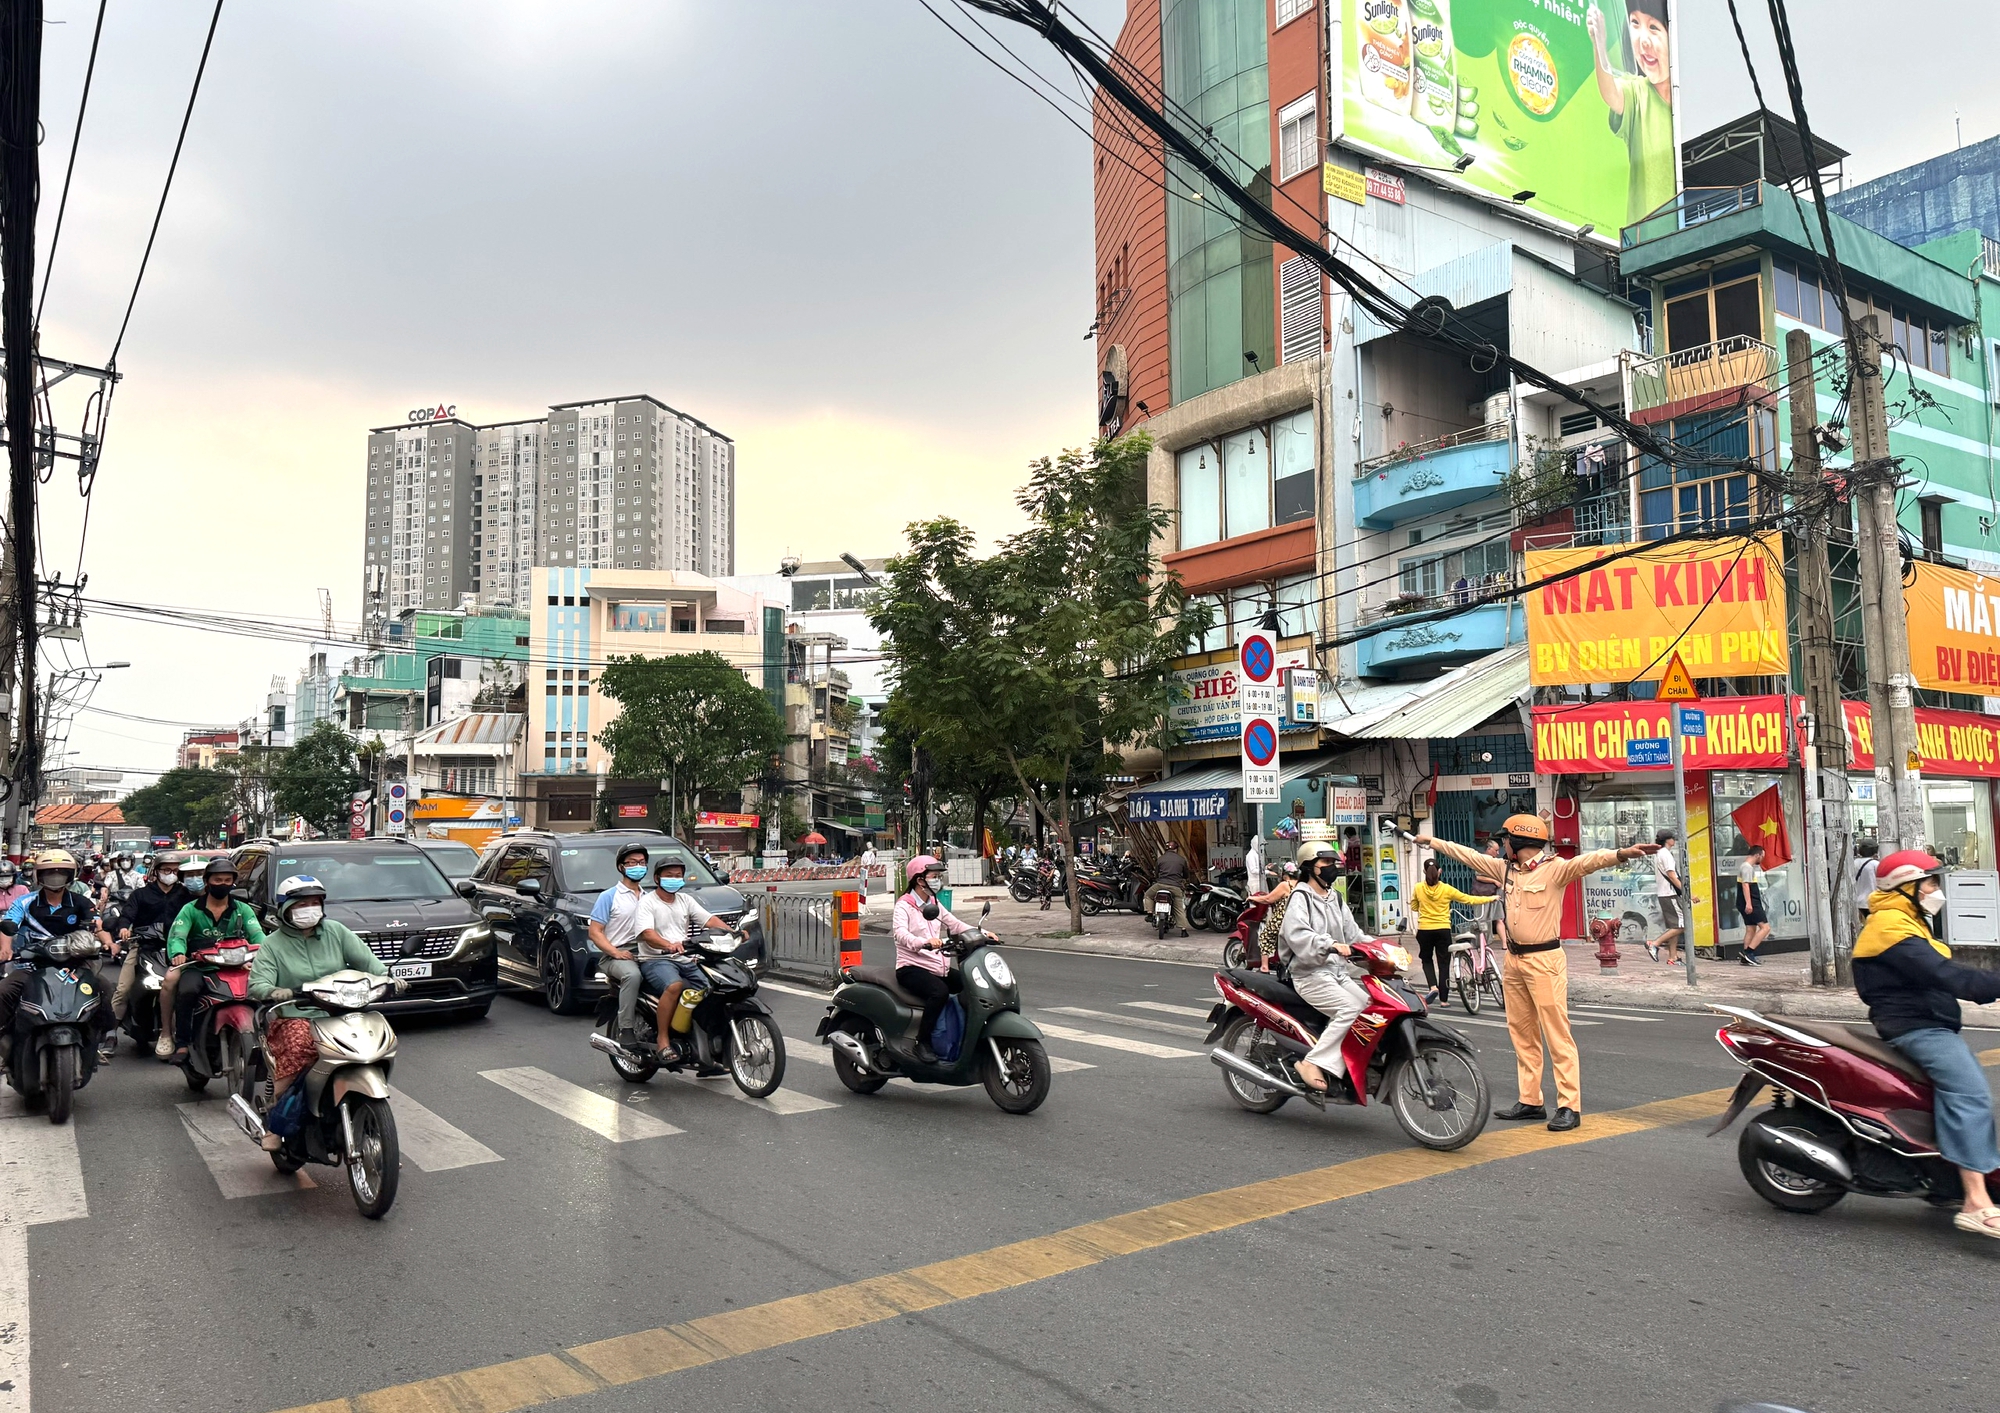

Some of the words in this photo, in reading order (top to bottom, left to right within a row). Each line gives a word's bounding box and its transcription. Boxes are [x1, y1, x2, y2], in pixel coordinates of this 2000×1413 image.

[1364, 1, 1398, 21] Sunlight
[1412, 24, 1443, 45] Sunlight
[1513, 58, 1554, 86] RHAMNO
[1374, 182, 1380, 194] 77
[1380, 184, 1387, 196] 44
[1387, 186, 1394, 199] 55
[408, 403, 456, 422] COPAC
[1654, 552, 1767, 608] KÍNH
[1537, 641, 1571, 674] BV
[1578, 633, 1641, 677] ĐIỆN
[1721, 620, 1780, 664] PHỦ
[1187, 669, 1207, 681] QUẢNG
[1208, 668, 1219, 679] CÁO
[1936, 645, 1962, 682] BV
[1967, 646, 2000, 694] ĐIỆ
[1194, 670, 1240, 700] HIỆ
[1667, 688, 1688, 698] CHẬM
[1231, 699, 1241, 708] PH
[1536, 714, 1588, 761] KÍNH
[1706, 705, 1782, 755] KHÁCH
[1635, 742, 1660, 750] ĐƯỜNG
[1950, 723, 1994, 771] ĐƯỢC
[1510, 774, 1529, 783] 96B
[1160, 798, 1188, 817] DANH
[1192, 793, 1225, 816] THIẾP
[1336, 790, 1352, 810] KHẮC
[1353, 793, 1365, 810] DẤU
[1341, 814, 1352, 823] DANH
[1353, 811, 1365, 823] THIẾP
[1513, 824, 1540, 834] CSGT
[1586, 888, 1611, 896] TRONG
[1783, 900, 1801, 916] 101
